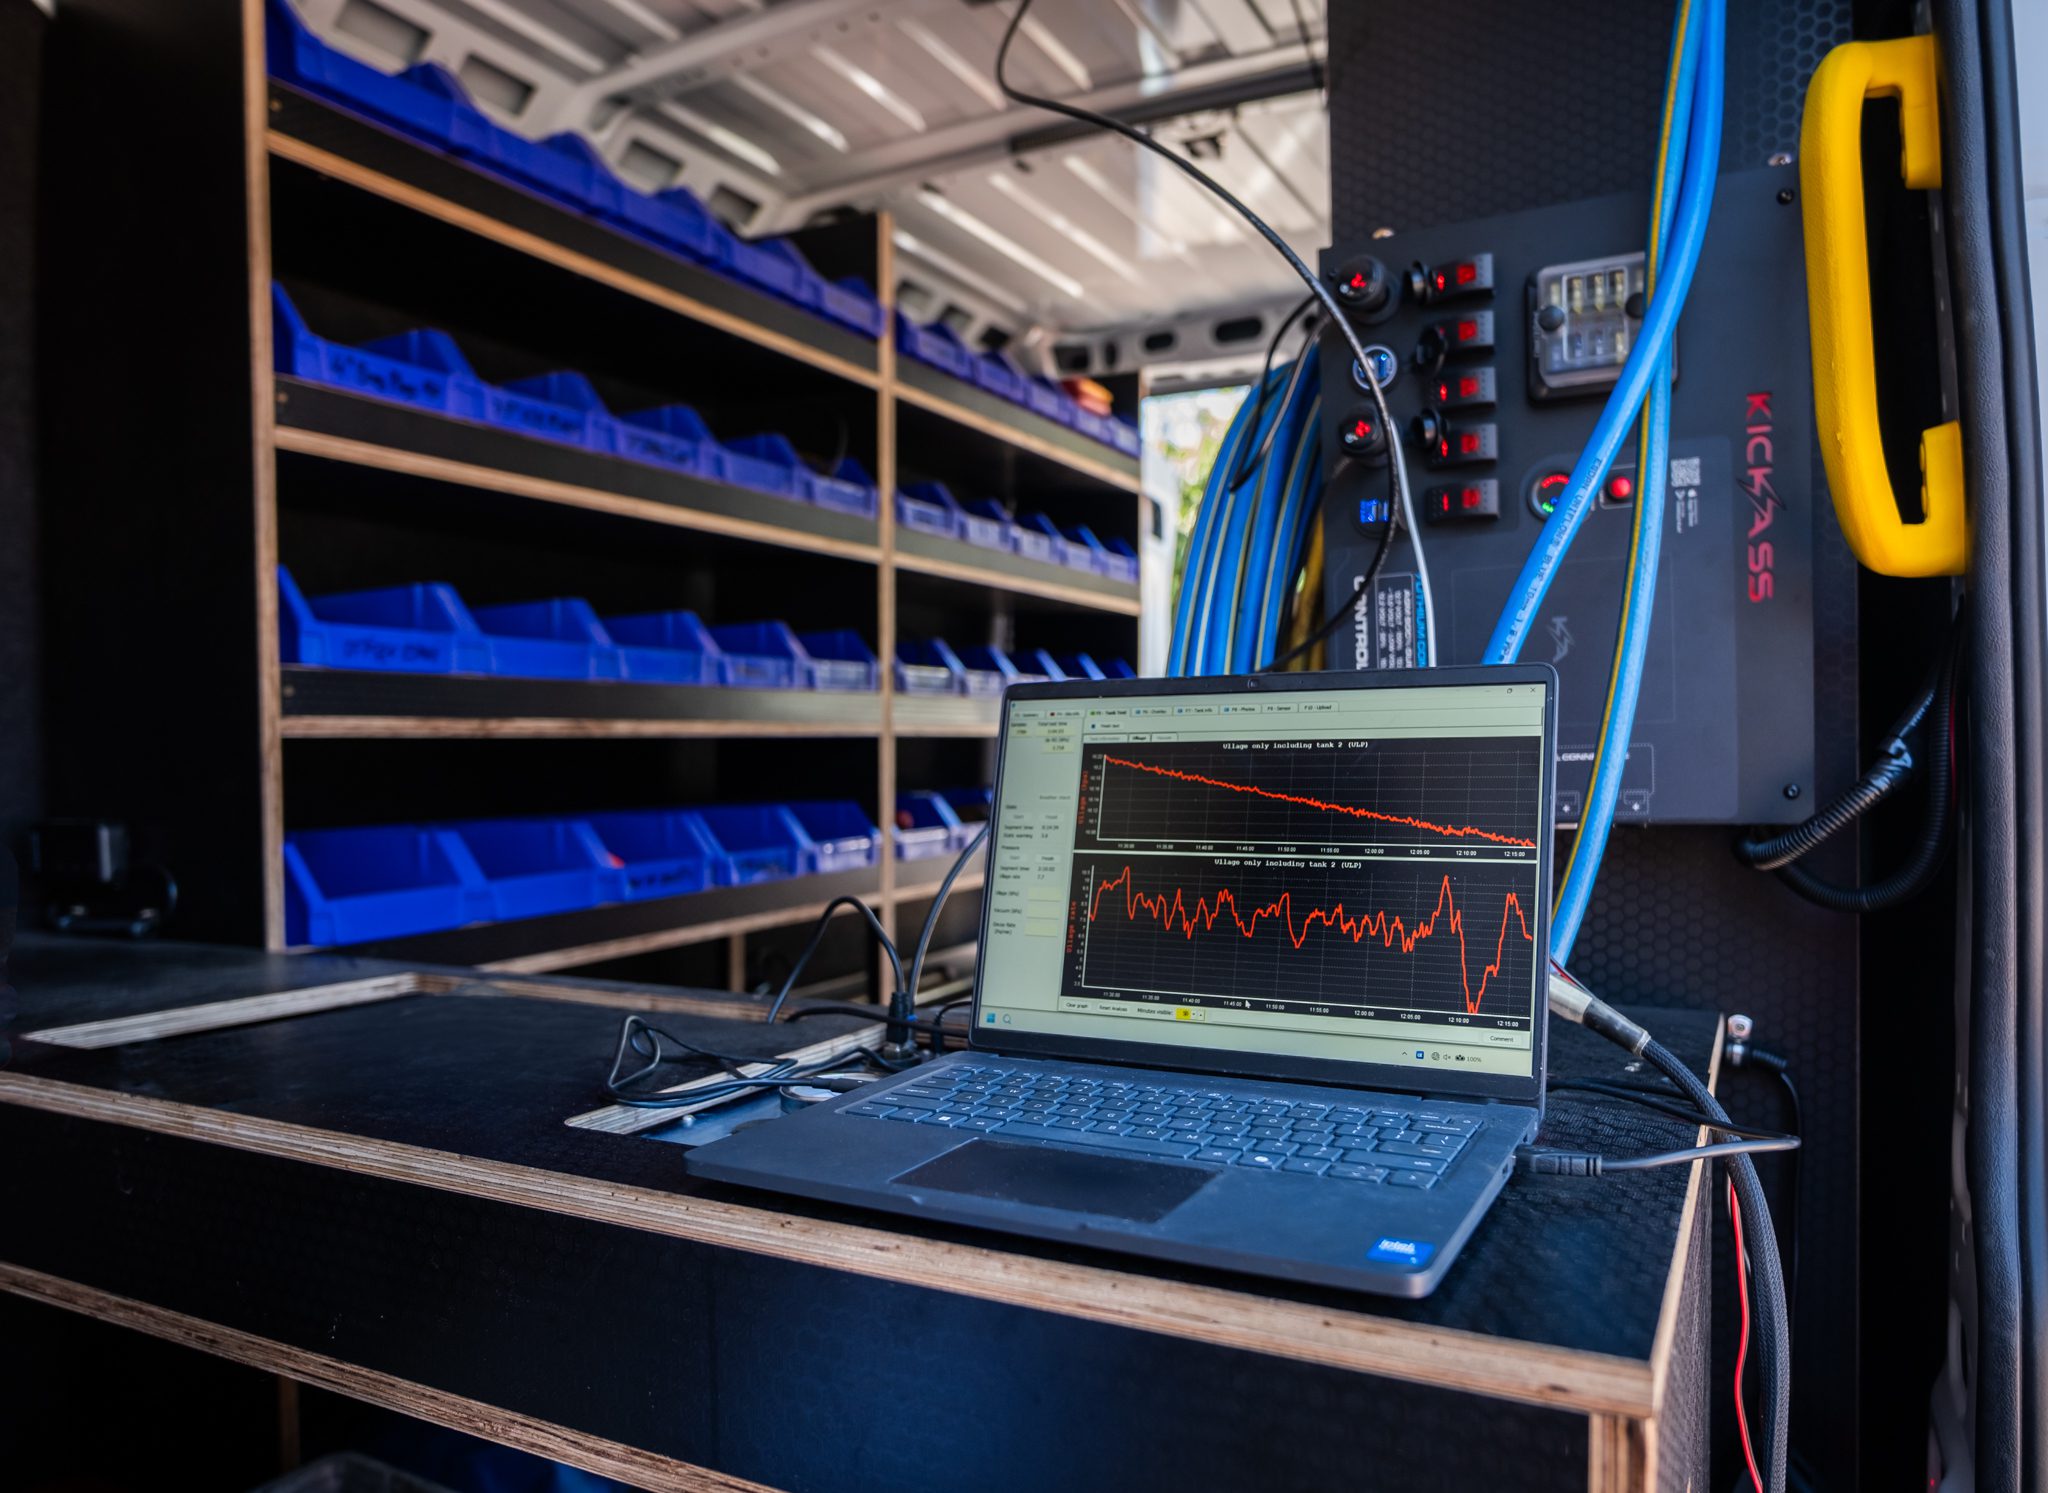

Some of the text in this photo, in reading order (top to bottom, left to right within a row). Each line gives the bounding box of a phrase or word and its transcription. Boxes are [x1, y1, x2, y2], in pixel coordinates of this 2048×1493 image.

[1745, 392, 1774, 603] KICKASS
[1353, 575, 1369, 670] CNTROL
[1273, 742, 1312, 750] including
[1244, 859, 1261, 867] only
[1265, 860, 1305, 868] including
